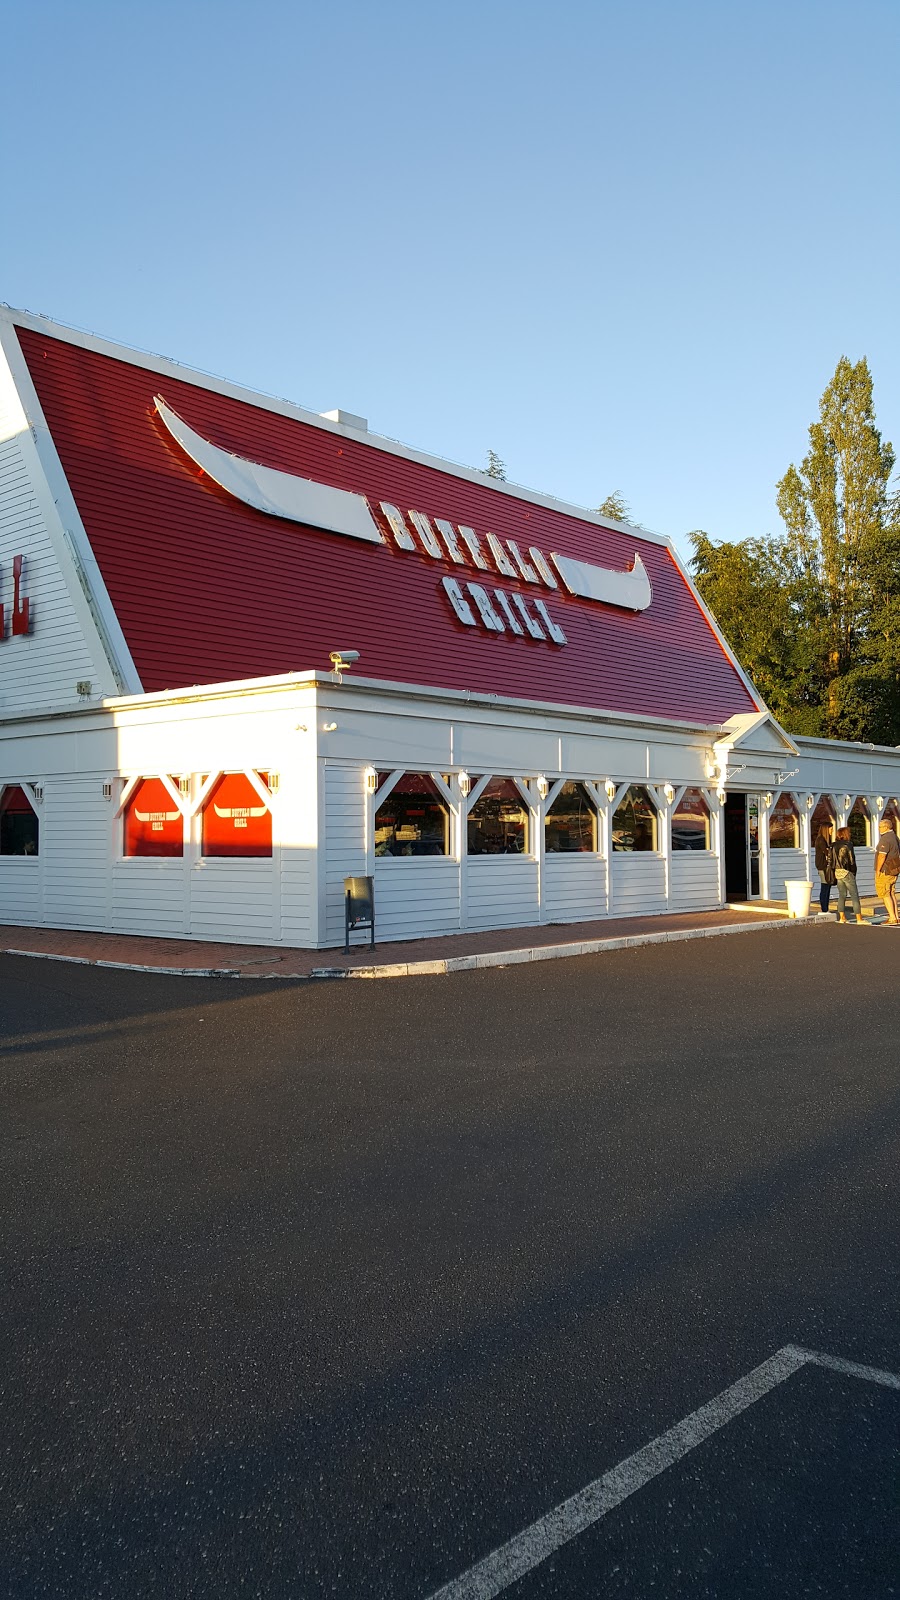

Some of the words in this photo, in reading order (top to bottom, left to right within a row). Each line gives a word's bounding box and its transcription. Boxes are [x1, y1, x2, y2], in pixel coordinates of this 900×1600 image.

[378, 500, 558, 589] BUFFALO
[441, 576, 568, 645] GRILL
[234, 818, 247, 827] GRILL
